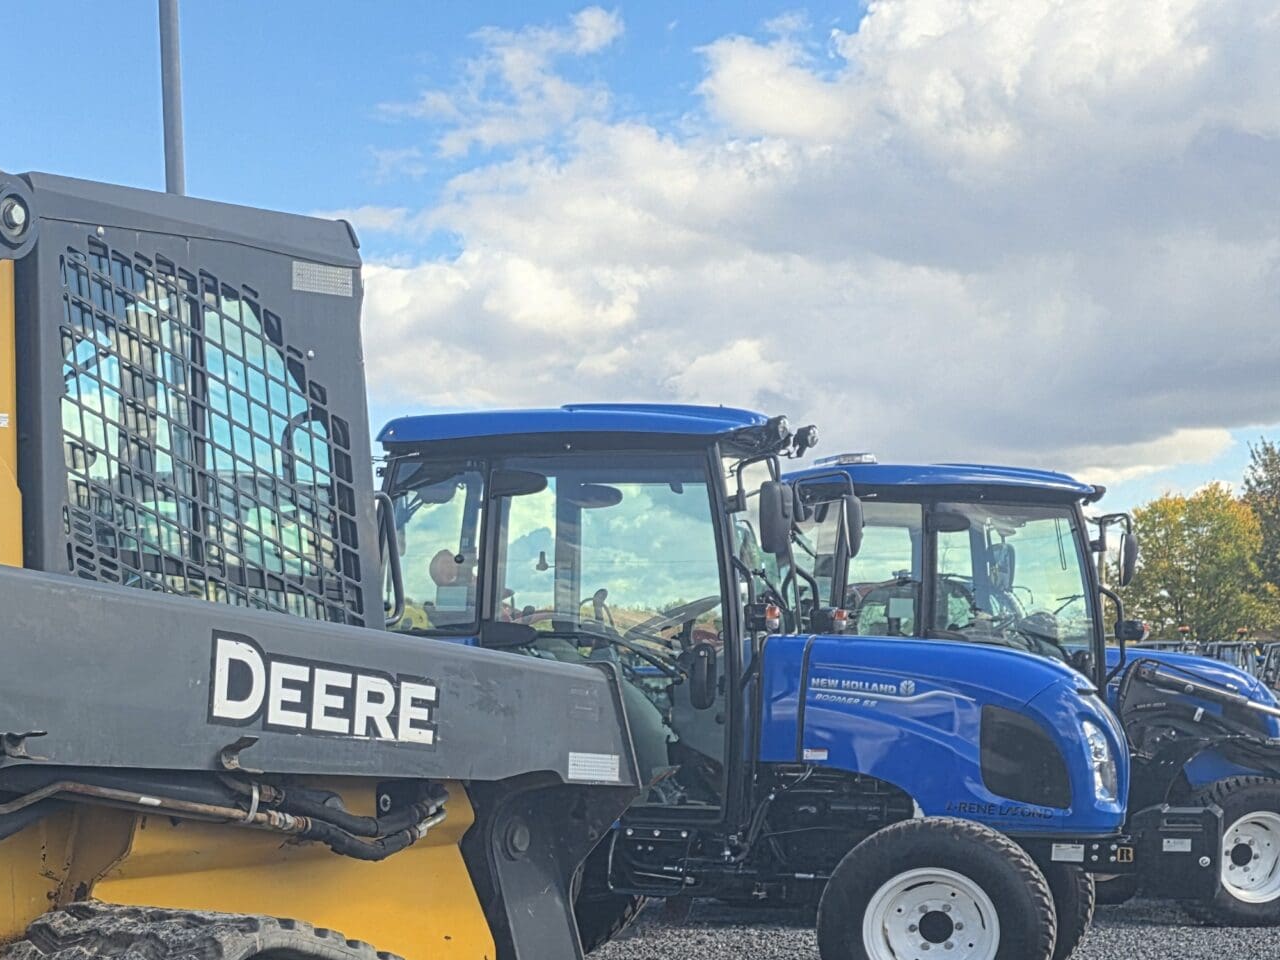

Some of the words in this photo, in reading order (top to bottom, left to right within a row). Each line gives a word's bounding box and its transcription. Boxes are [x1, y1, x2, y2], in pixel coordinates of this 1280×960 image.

[213, 638, 437, 745] DEERE
[811, 677, 838, 688] NEW
[841, 679, 897, 694] HOLLAND
[815, 693, 860, 705] BOOMER
